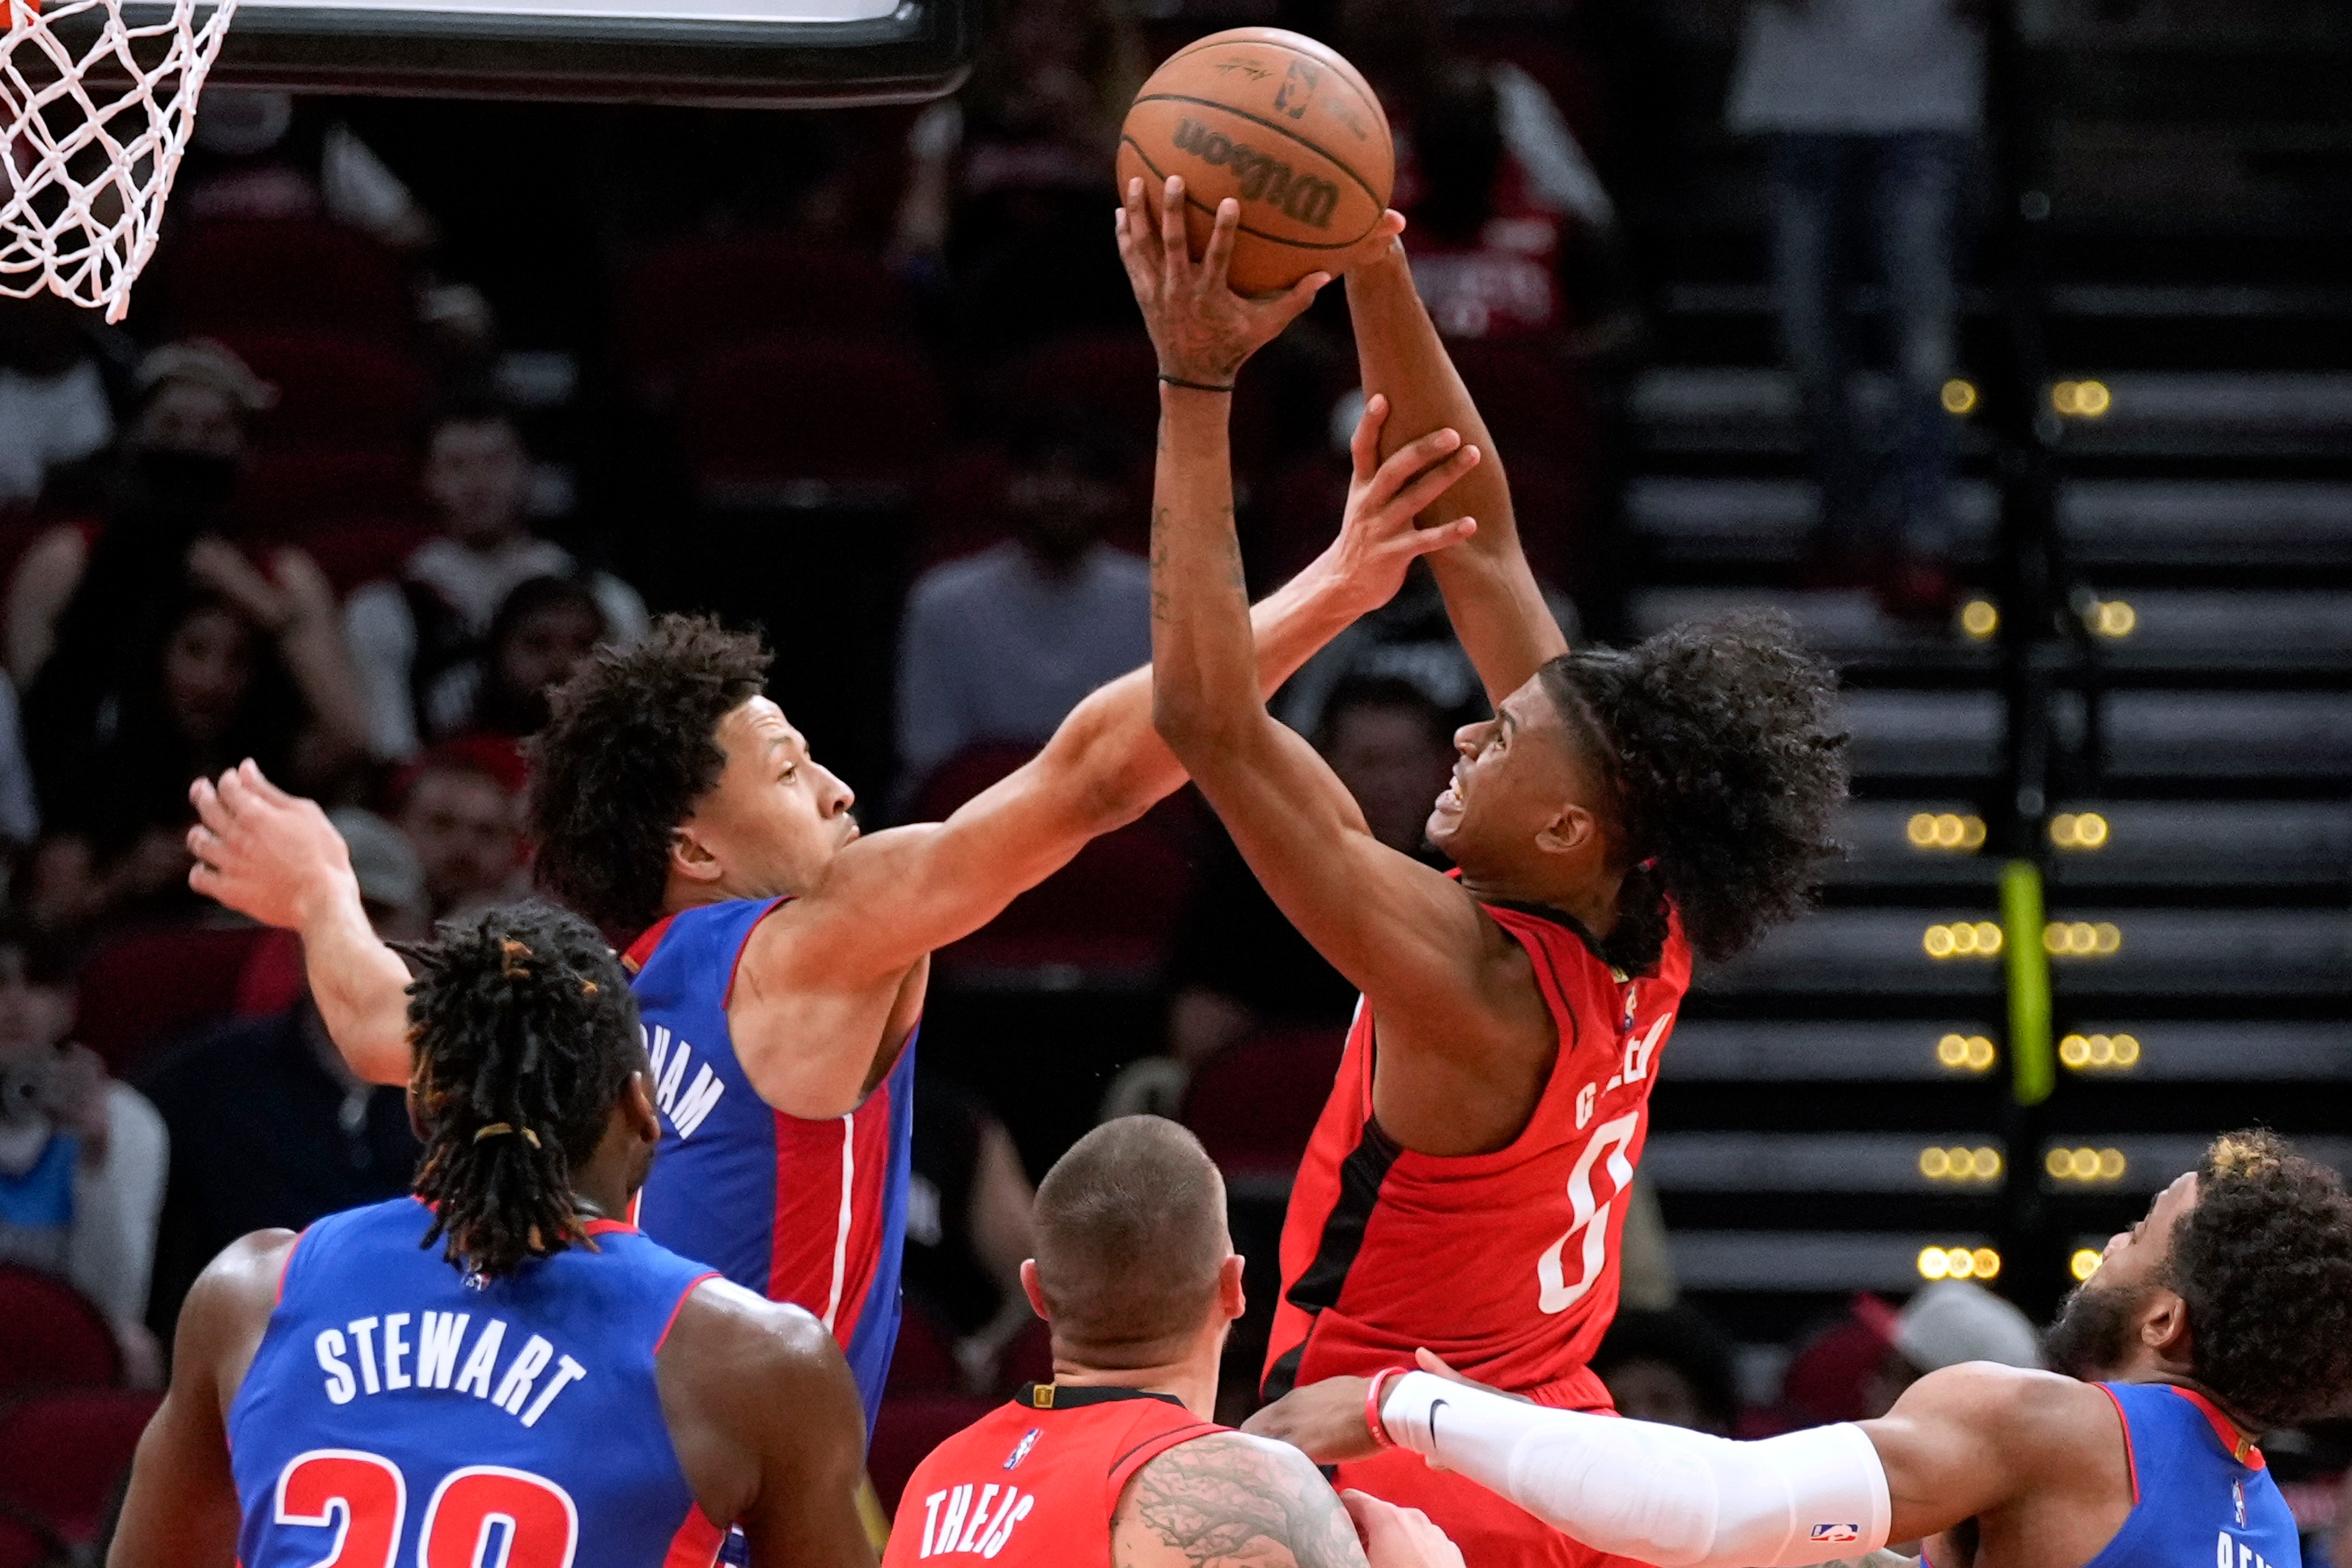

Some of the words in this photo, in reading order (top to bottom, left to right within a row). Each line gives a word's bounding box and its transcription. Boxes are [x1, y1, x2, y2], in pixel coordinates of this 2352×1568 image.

[1173, 116, 1340, 230] Wilson
[639, 1023, 725, 1140] HAM
[314, 1311, 587, 1428] STEWART
[920, 1483, 1035, 1559] THEIS
